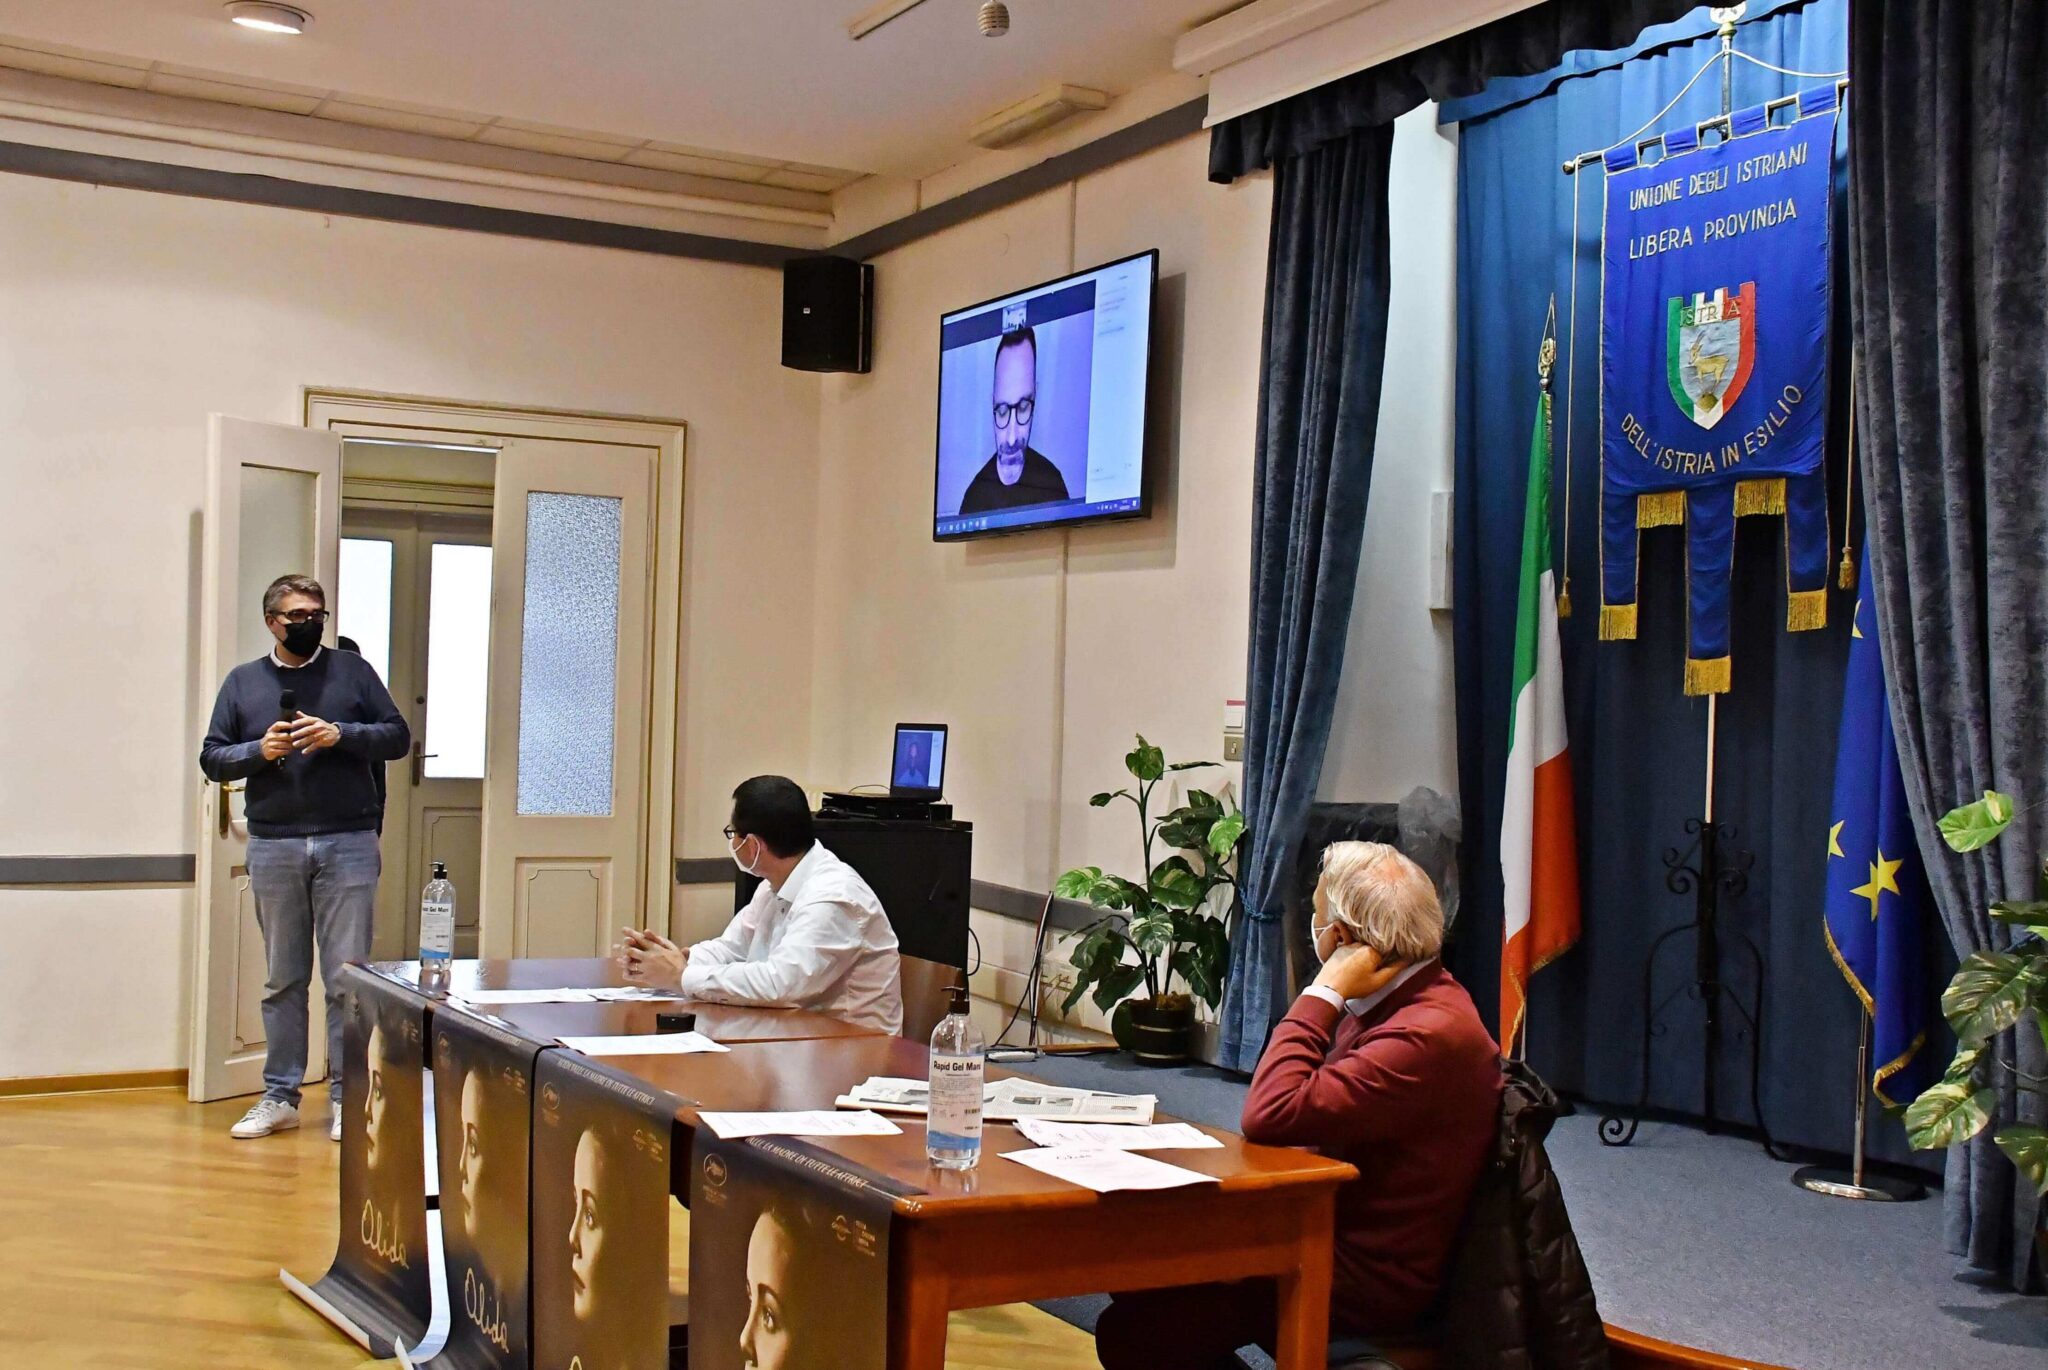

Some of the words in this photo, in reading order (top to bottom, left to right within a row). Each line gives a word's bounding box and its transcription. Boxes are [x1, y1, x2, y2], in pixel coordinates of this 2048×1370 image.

[1629, 178, 1682, 211] UNIONE
[1689, 168, 1728, 197] DEGLI
[1737, 143, 1807, 182] ISTRIANI
[1629, 226, 1693, 259] LIBERA
[1704, 198, 1797, 244] PROVINCIA
[1621, 413, 1715, 474] DELL'ISTRIA
[1722, 442, 1740, 468] IN
[1745, 384, 1802, 455] ESILIO
[934, 1061, 951, 1072] Rapid
[952, 1062, 964, 1071] Gel
